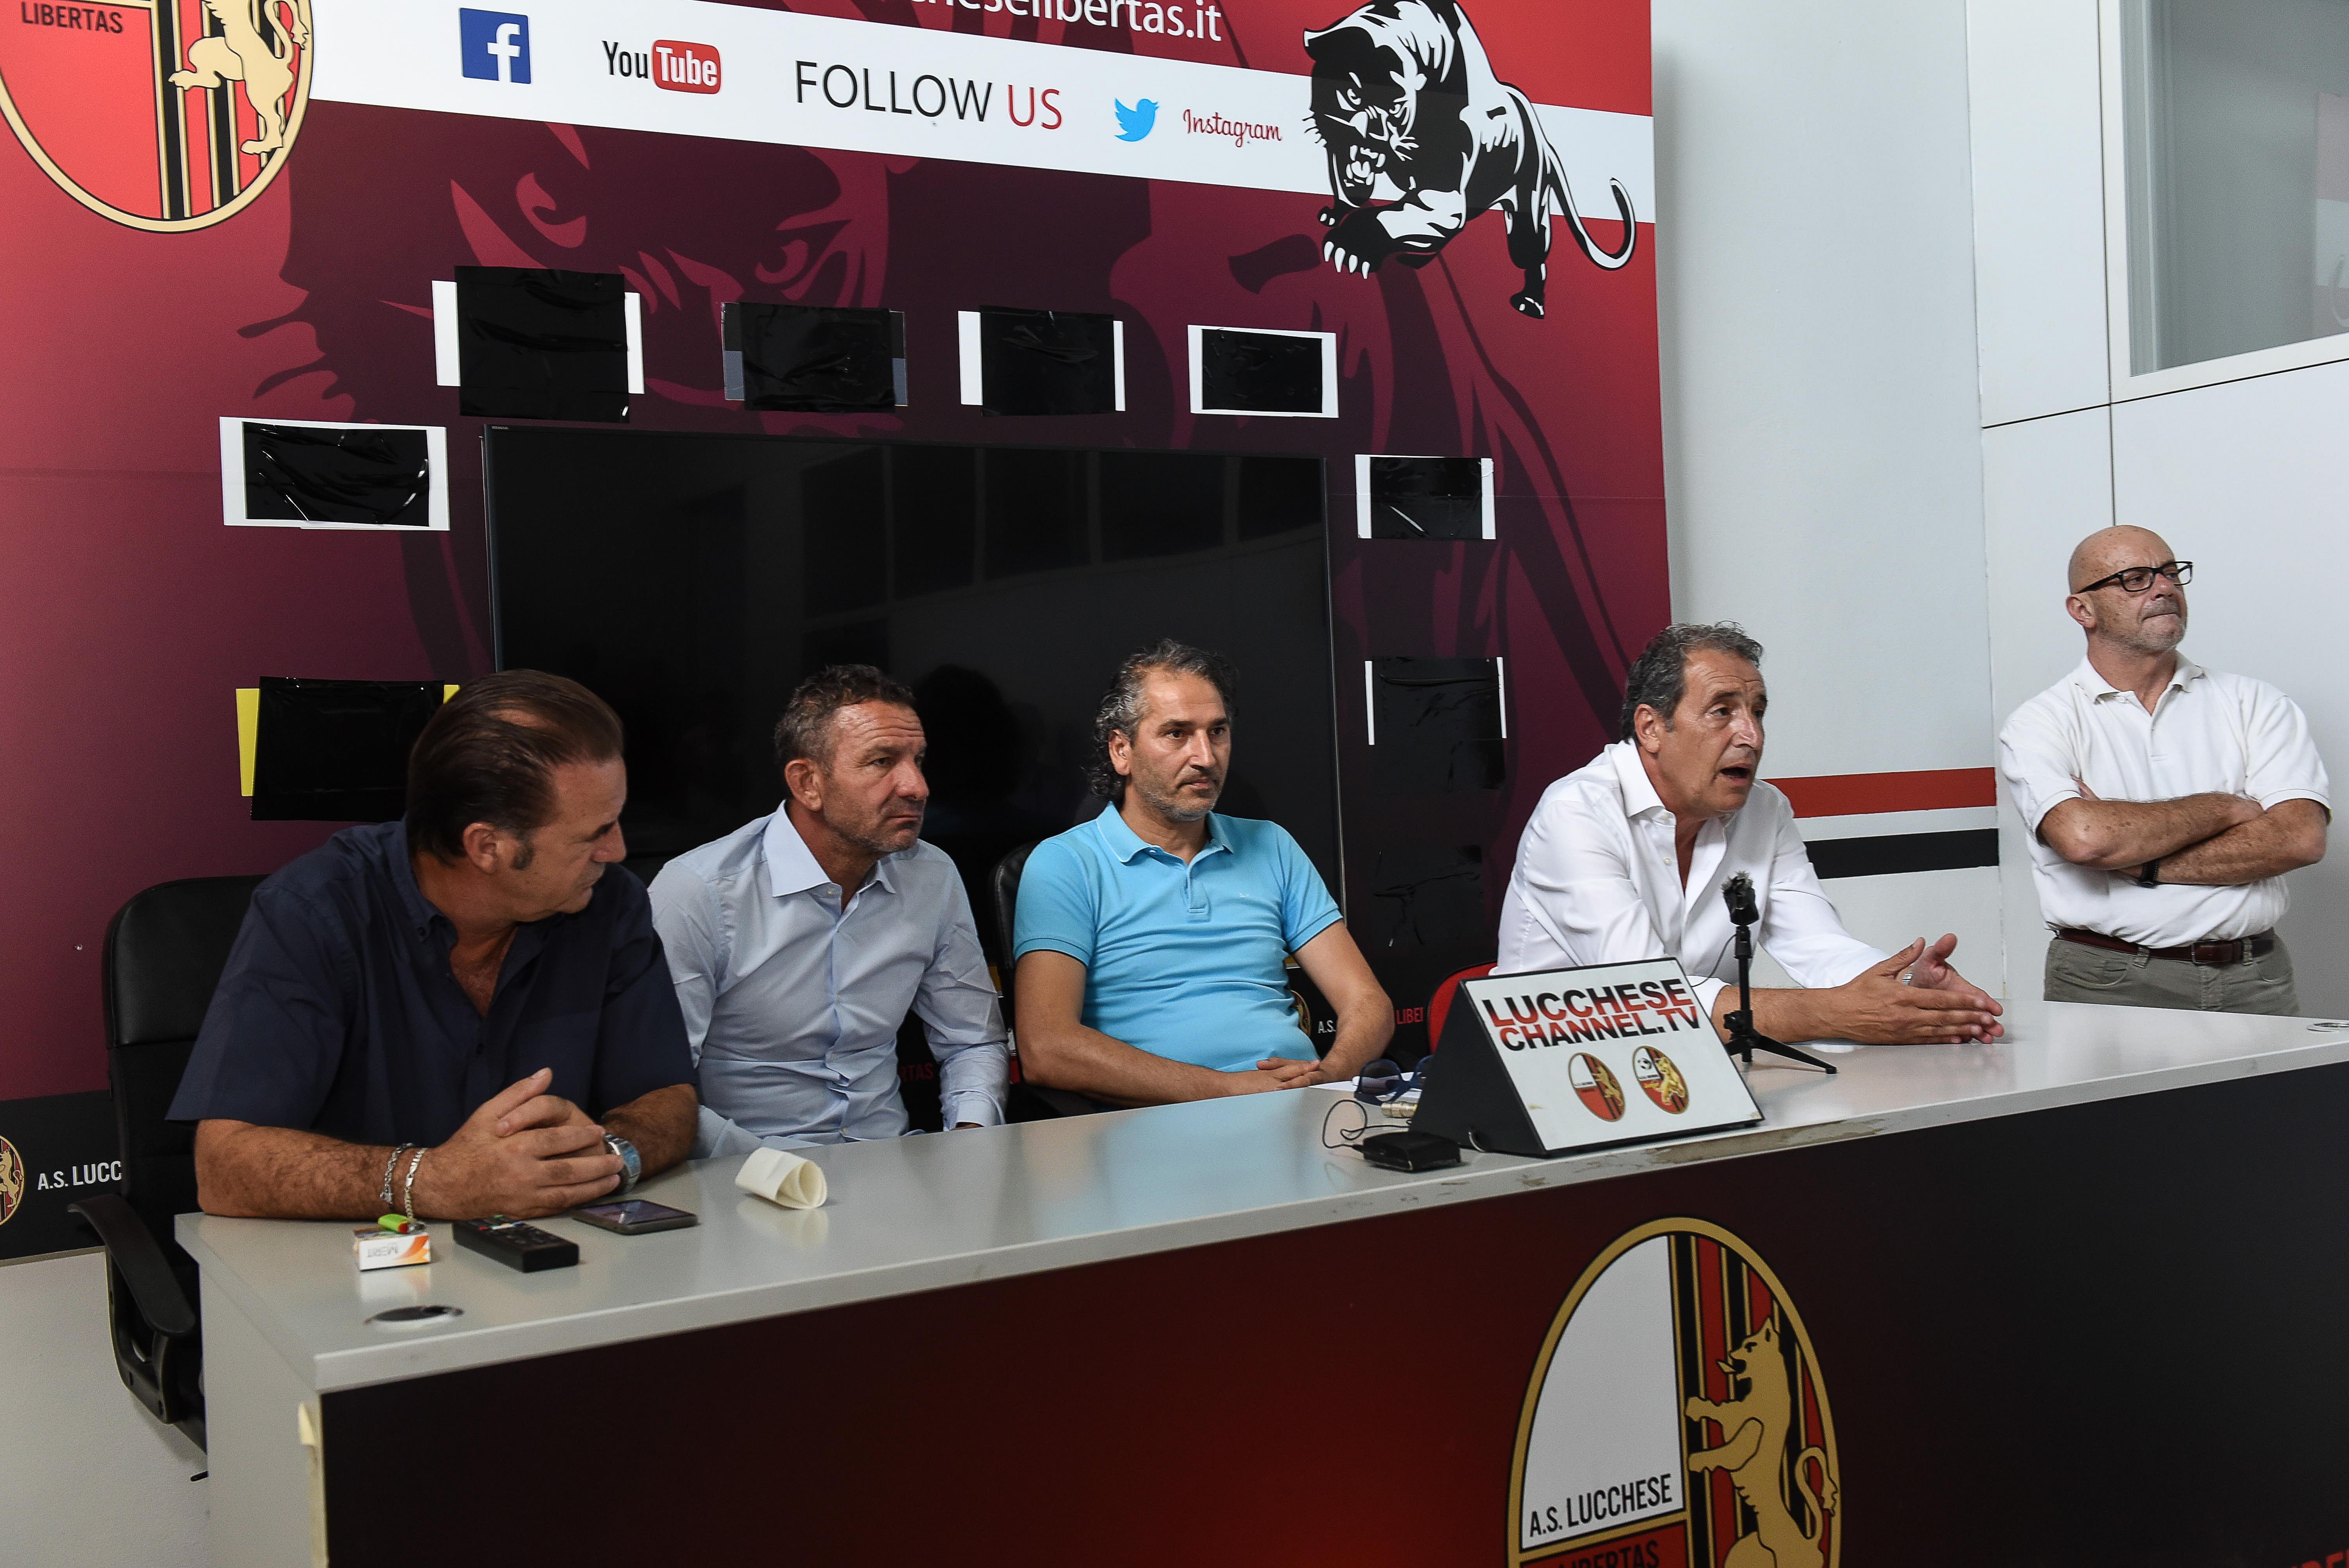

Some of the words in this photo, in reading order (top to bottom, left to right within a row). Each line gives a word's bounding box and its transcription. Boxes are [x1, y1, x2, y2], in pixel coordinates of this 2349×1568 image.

[21, 1, 123, 34] LIBERTAS
[911, 0, 1222, 41] ebertas.it
[795, 60, 993, 122] FOLLOW
[1008, 84, 1062, 130] US
[1183, 109, 1282, 148] Instagram
[1481, 978, 1693, 1027] LUCCHESE
[1318, 1020, 1336, 1034] A.S.
[1500, 1006, 1700, 1051] CHANNEL.TV
[38, 1171, 68, 1190] A.S.
[73, 1161, 121, 1186] LUCC
[1530, 1506, 1563, 1538] A.S.
[1567, 1473, 1672, 1527] LUCCHESE
[1559, 1540, 1660, 1568] ERTAS
